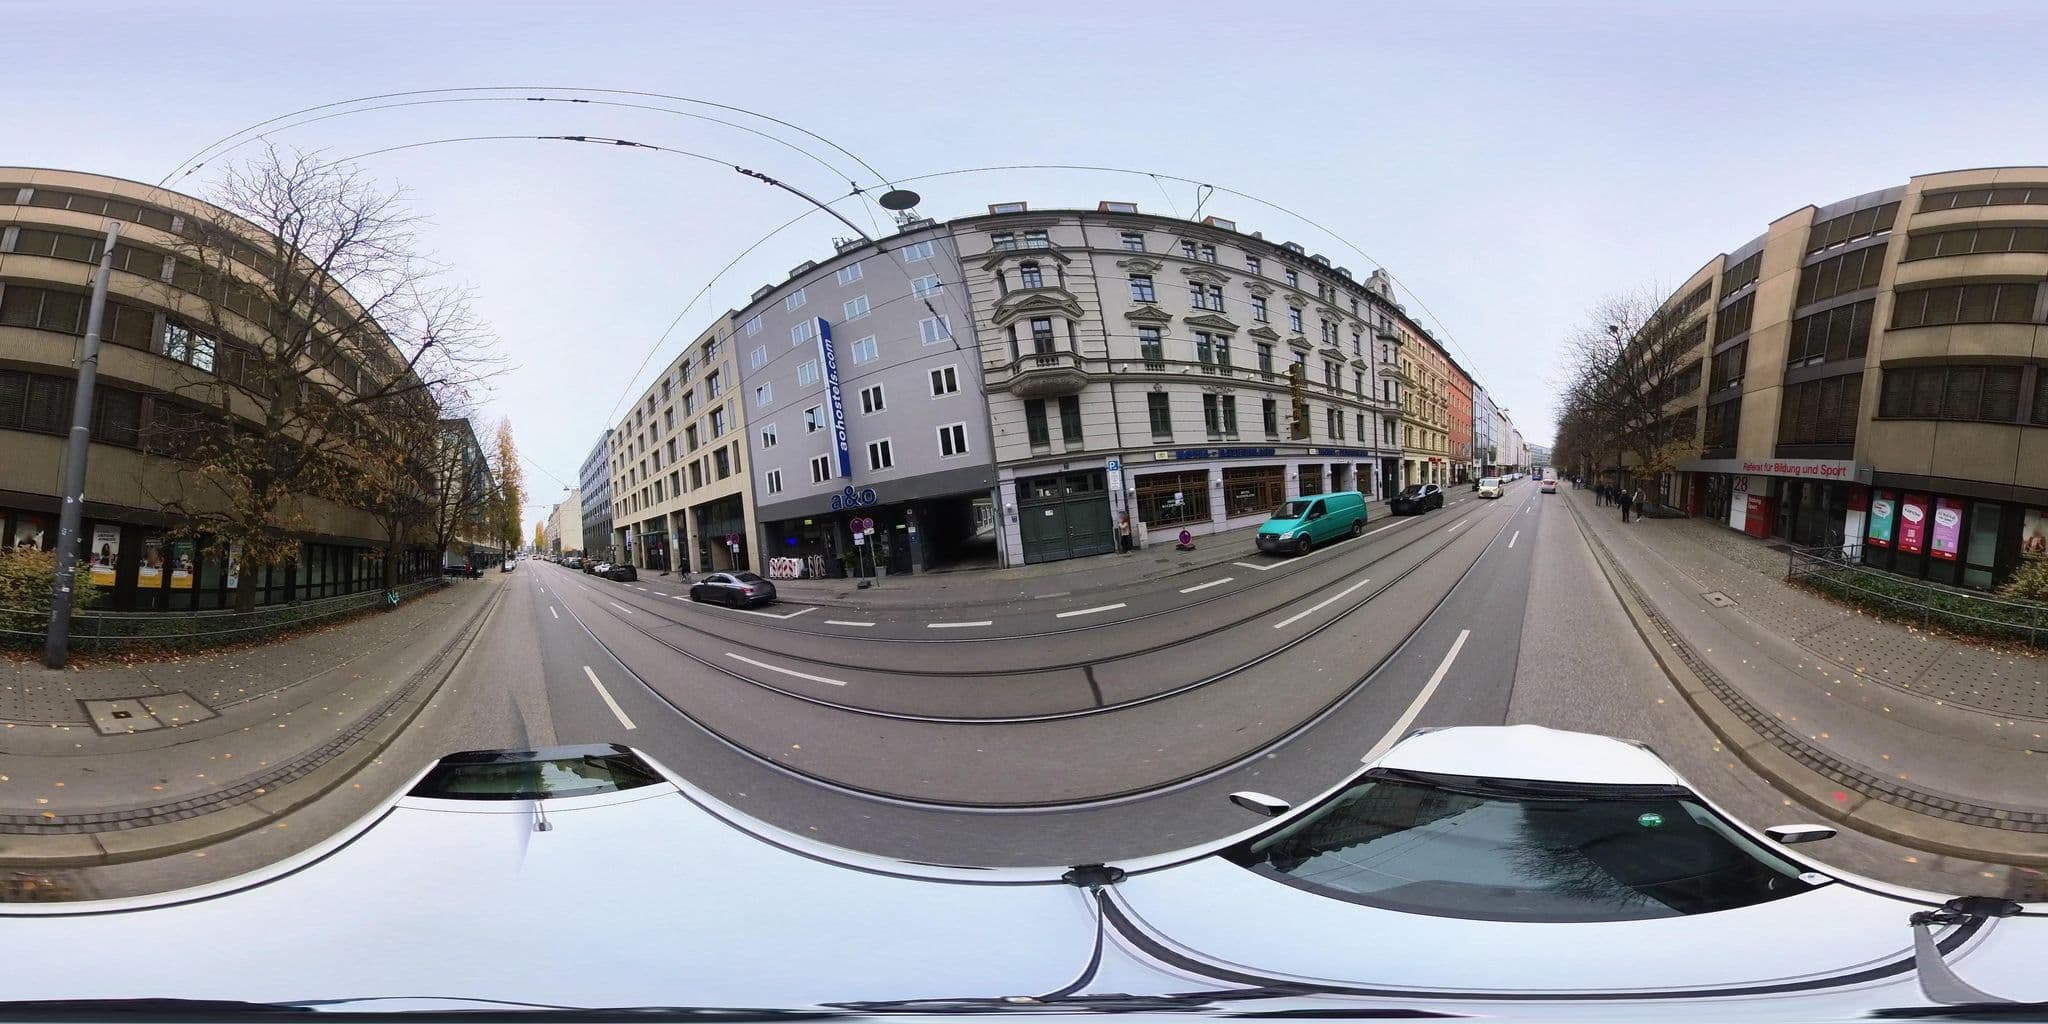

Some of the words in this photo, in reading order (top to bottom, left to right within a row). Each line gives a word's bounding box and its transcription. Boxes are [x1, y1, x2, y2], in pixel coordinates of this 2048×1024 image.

[824, 338, 848, 451] aohostels.com
[1743, 462, 1763, 472] Referat
[1763, 462, 1773, 472] für
[1774, 463, 1800, 476] Bildung
[1802, 464, 1818, 475] und
[1820, 464, 1847, 477] Sport
[1735, 476, 1748, 492] 28
[831, 485, 877, 510] a&o
